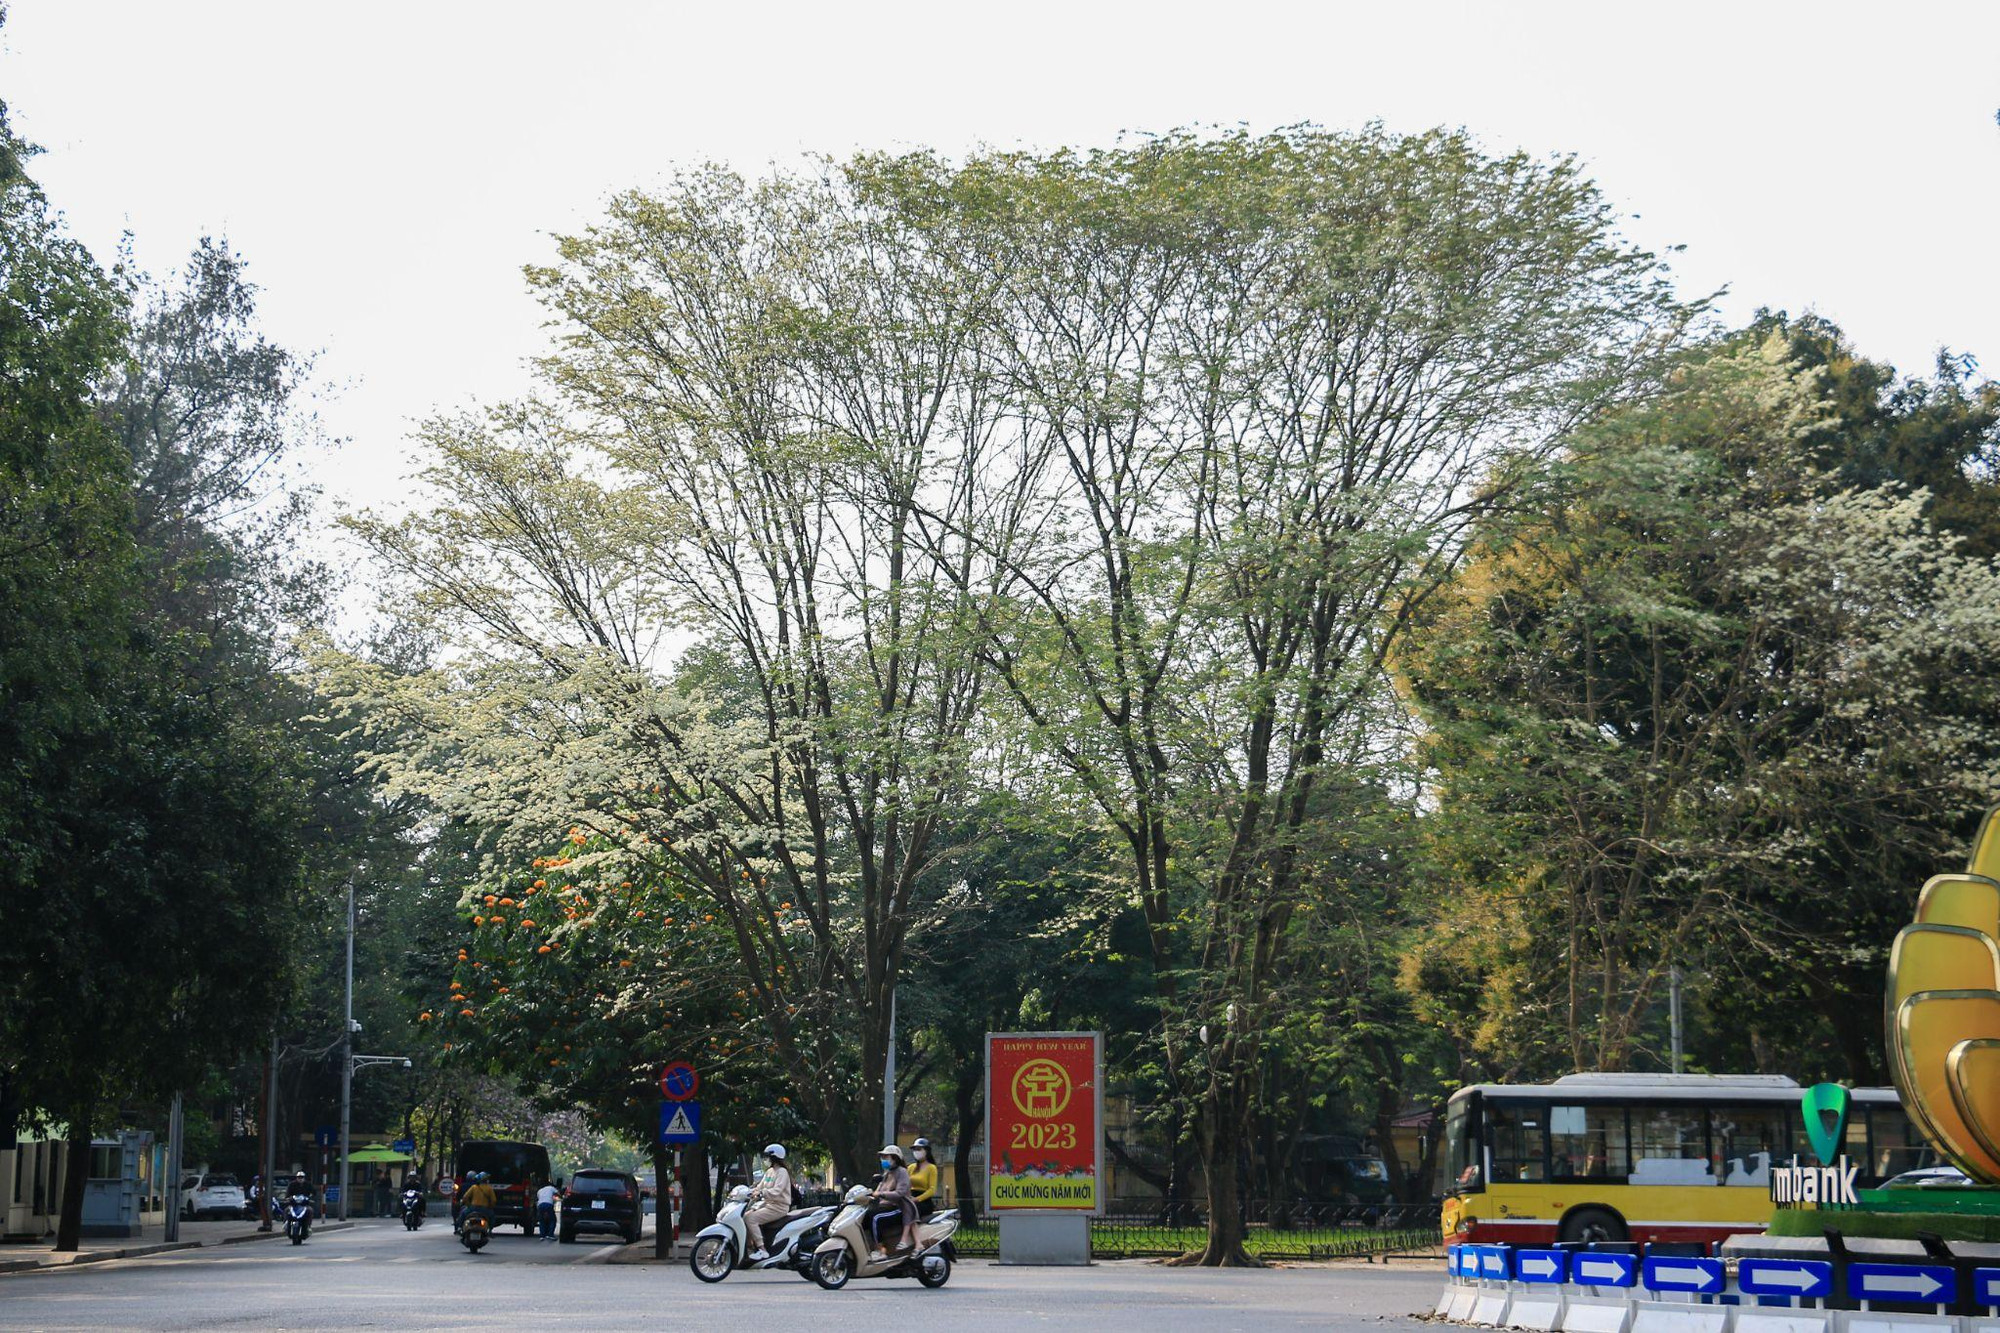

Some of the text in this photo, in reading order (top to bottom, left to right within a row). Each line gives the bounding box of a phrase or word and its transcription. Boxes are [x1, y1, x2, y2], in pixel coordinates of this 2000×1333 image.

[1003, 1041, 1087, 1051] HAPPY NEW YEAR
[1011, 1123, 1076, 1149] 2023
[1772, 1153, 1859, 1204] mbank
[995, 1183, 1091, 1199] CHÚC MỪNG NĂM MỚI
